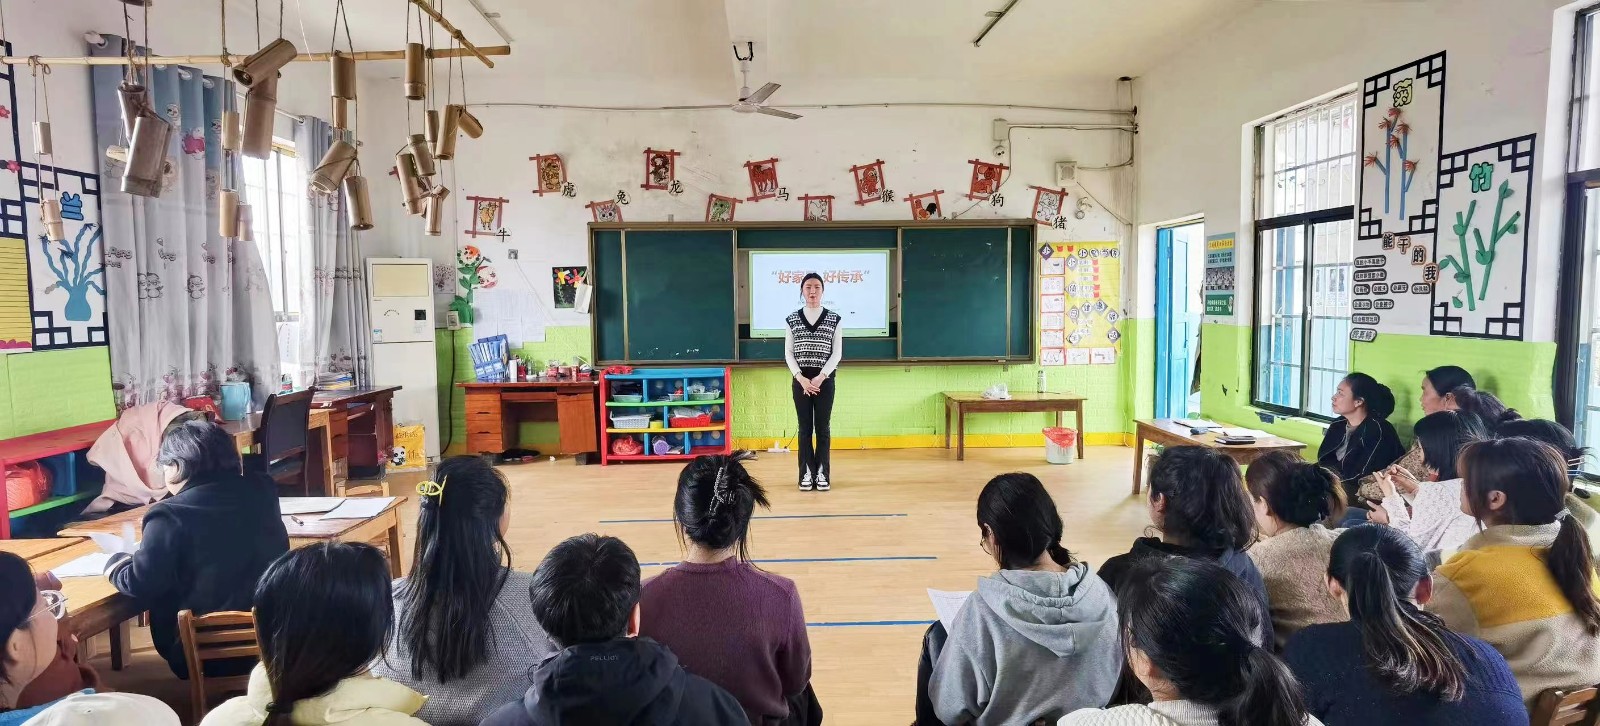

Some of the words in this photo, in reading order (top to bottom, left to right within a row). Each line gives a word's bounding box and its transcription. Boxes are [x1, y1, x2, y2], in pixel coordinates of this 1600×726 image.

[1469, 162, 1494, 193] 竹
[562, 182, 577, 197] 虎
[669, 180, 684, 194] 龙
[777, 187, 790, 201] 马
[616, 190, 629, 205] 兔
[881, 189, 894, 203] 猴
[991, 193, 1004, 207] 狗
[60, 191, 84, 221] 兰
[1053, 216, 1067, 230] 猪
[496, 228, 510, 242] 牛
[1383, 234, 1436, 280] 能干的我
